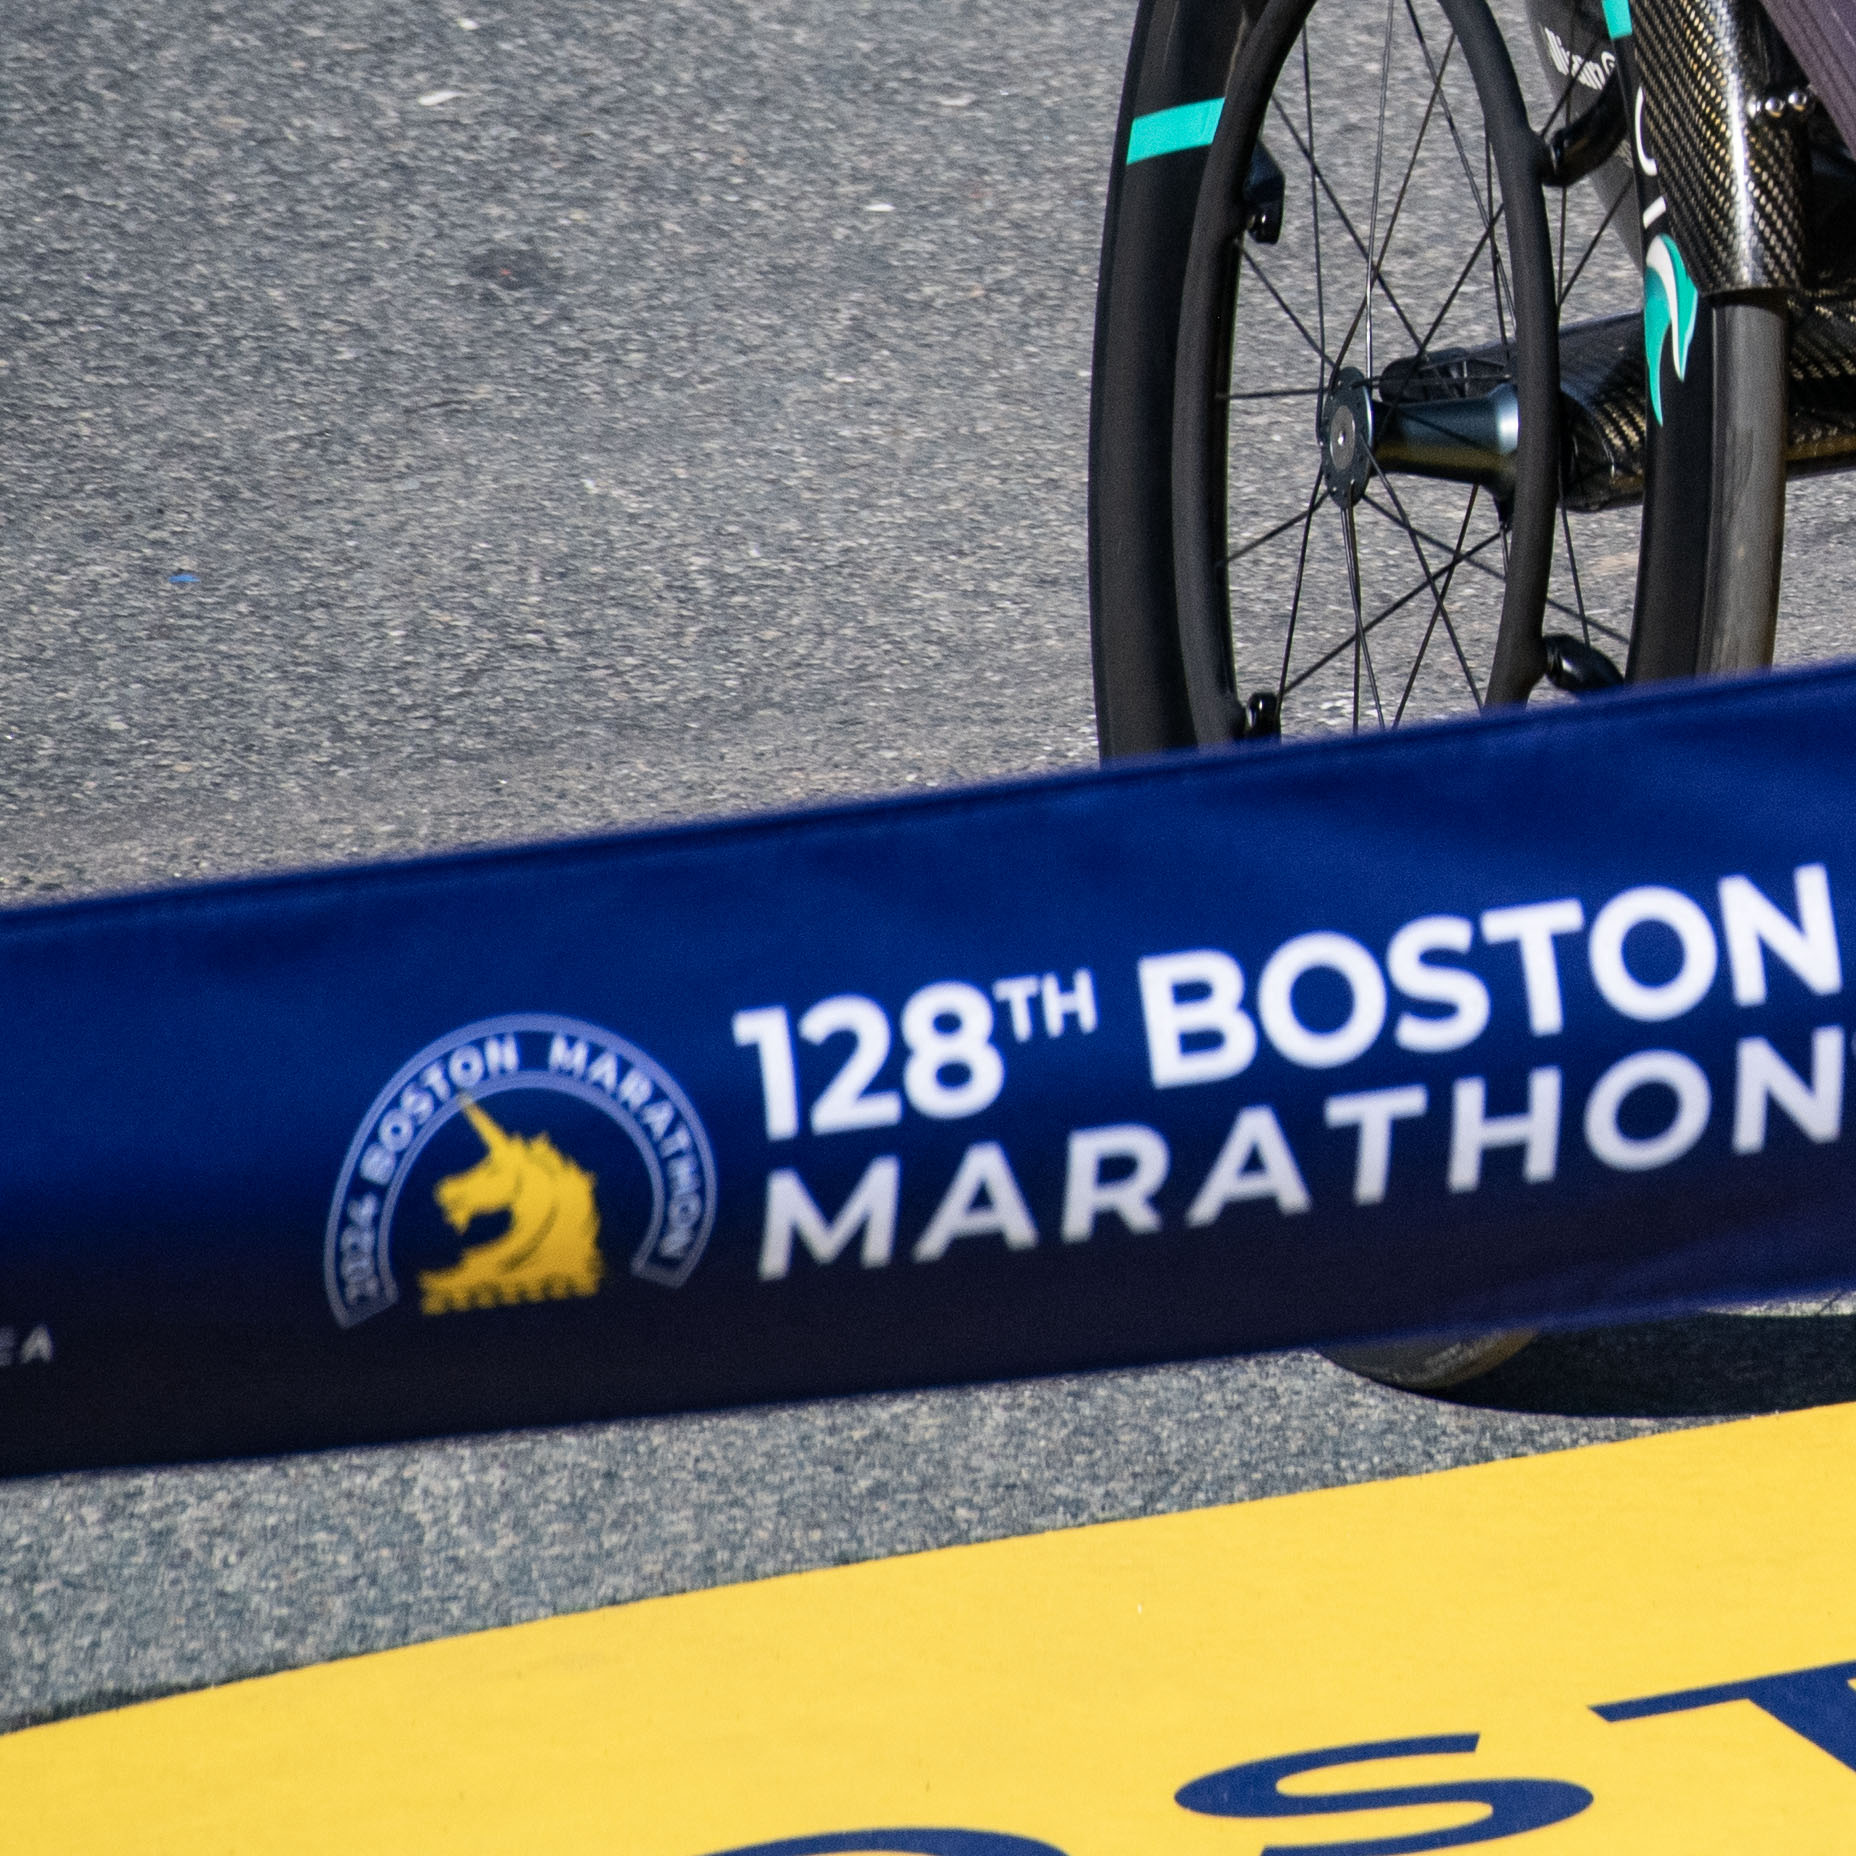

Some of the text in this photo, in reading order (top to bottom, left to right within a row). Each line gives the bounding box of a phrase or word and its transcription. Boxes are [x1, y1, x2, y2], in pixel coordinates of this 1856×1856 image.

[733, 863, 1843, 1140] 128TH BOSTON
[343, 1032, 705, 1303] 2024 BOSTON MARATHON
